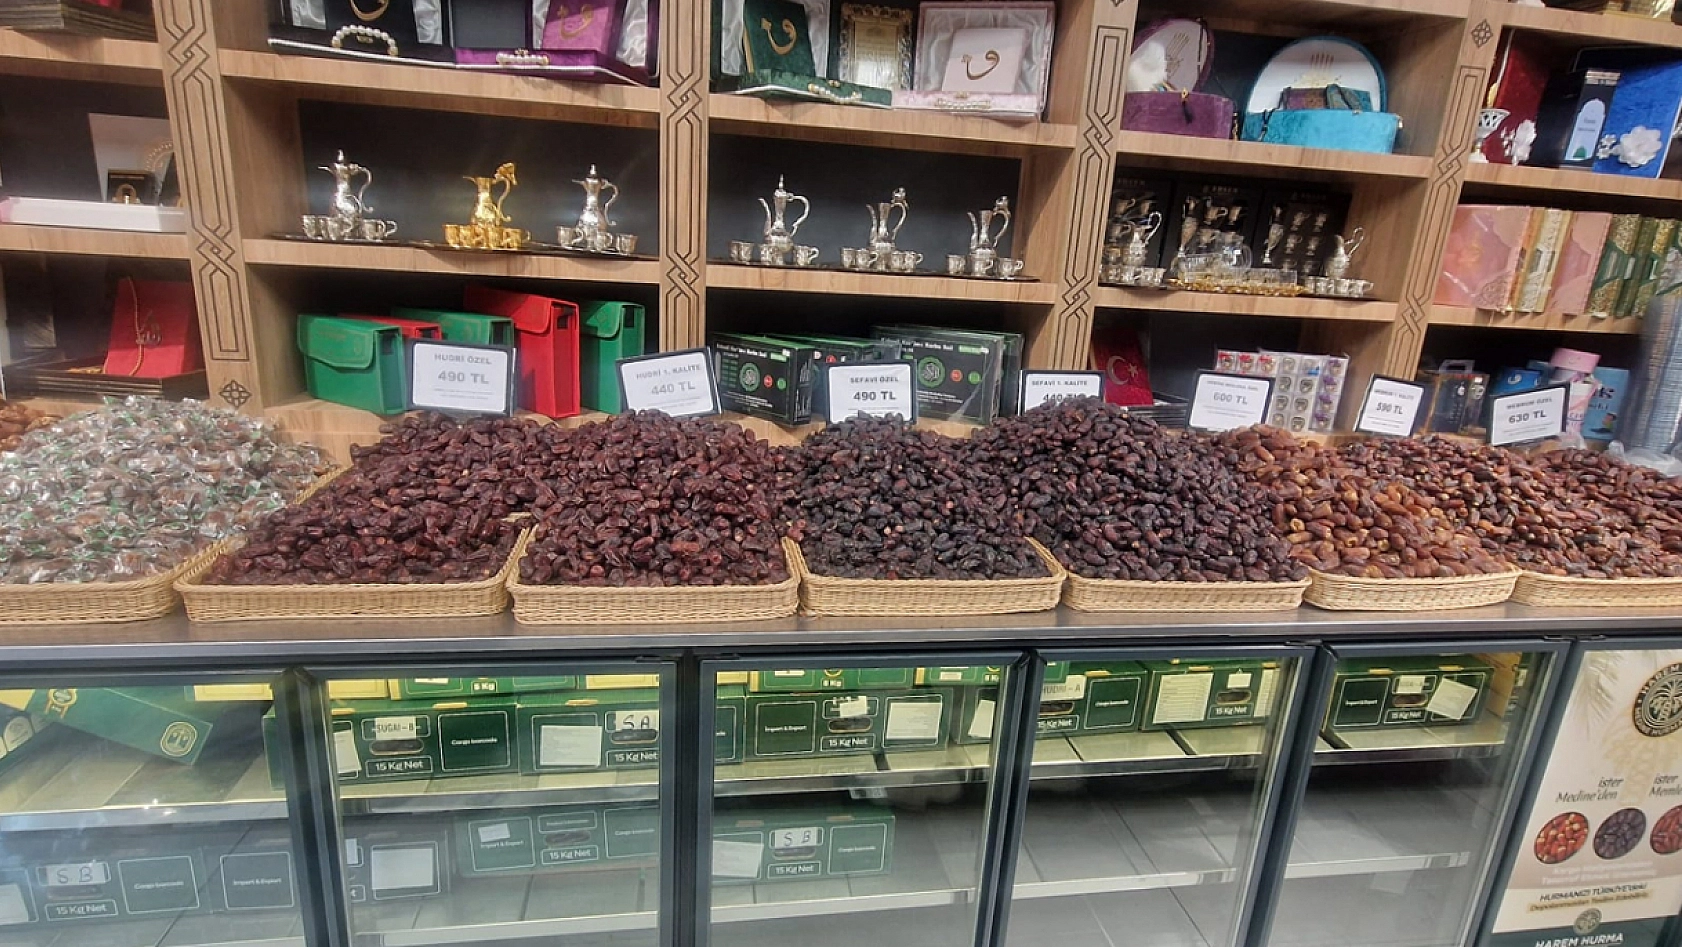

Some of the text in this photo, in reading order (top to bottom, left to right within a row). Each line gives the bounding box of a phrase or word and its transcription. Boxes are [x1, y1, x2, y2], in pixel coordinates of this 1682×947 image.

[466, 355, 492, 365] ÖZEL
[438, 370, 489, 384] 490 TL
[651, 380, 696, 395] 440 TL
[853, 391, 897, 401] 490 TL
[1213, 391, 1248, 405] 600 TL
[1394, 405, 1403, 415] TL
[1508, 409, 1547, 423] 630 TL
[1224, 707, 1233, 715] Kg
[1234, 706, 1248, 714] Net
[1047, 720, 1057, 728] Kg
[1058, 719, 1072, 727] Net
[829, 737, 868, 748] 15 Kg Net
[615, 751, 659, 763] 15 Kg Net
[375, 760, 424, 771] 15 Kg Net
[550, 849, 591, 860] 15 Kg Net
[775, 864, 814, 874] 15 Kg Net
[56, 903, 108, 915] 15 Kg Net
[1581, 932, 1624, 945] HURMA
